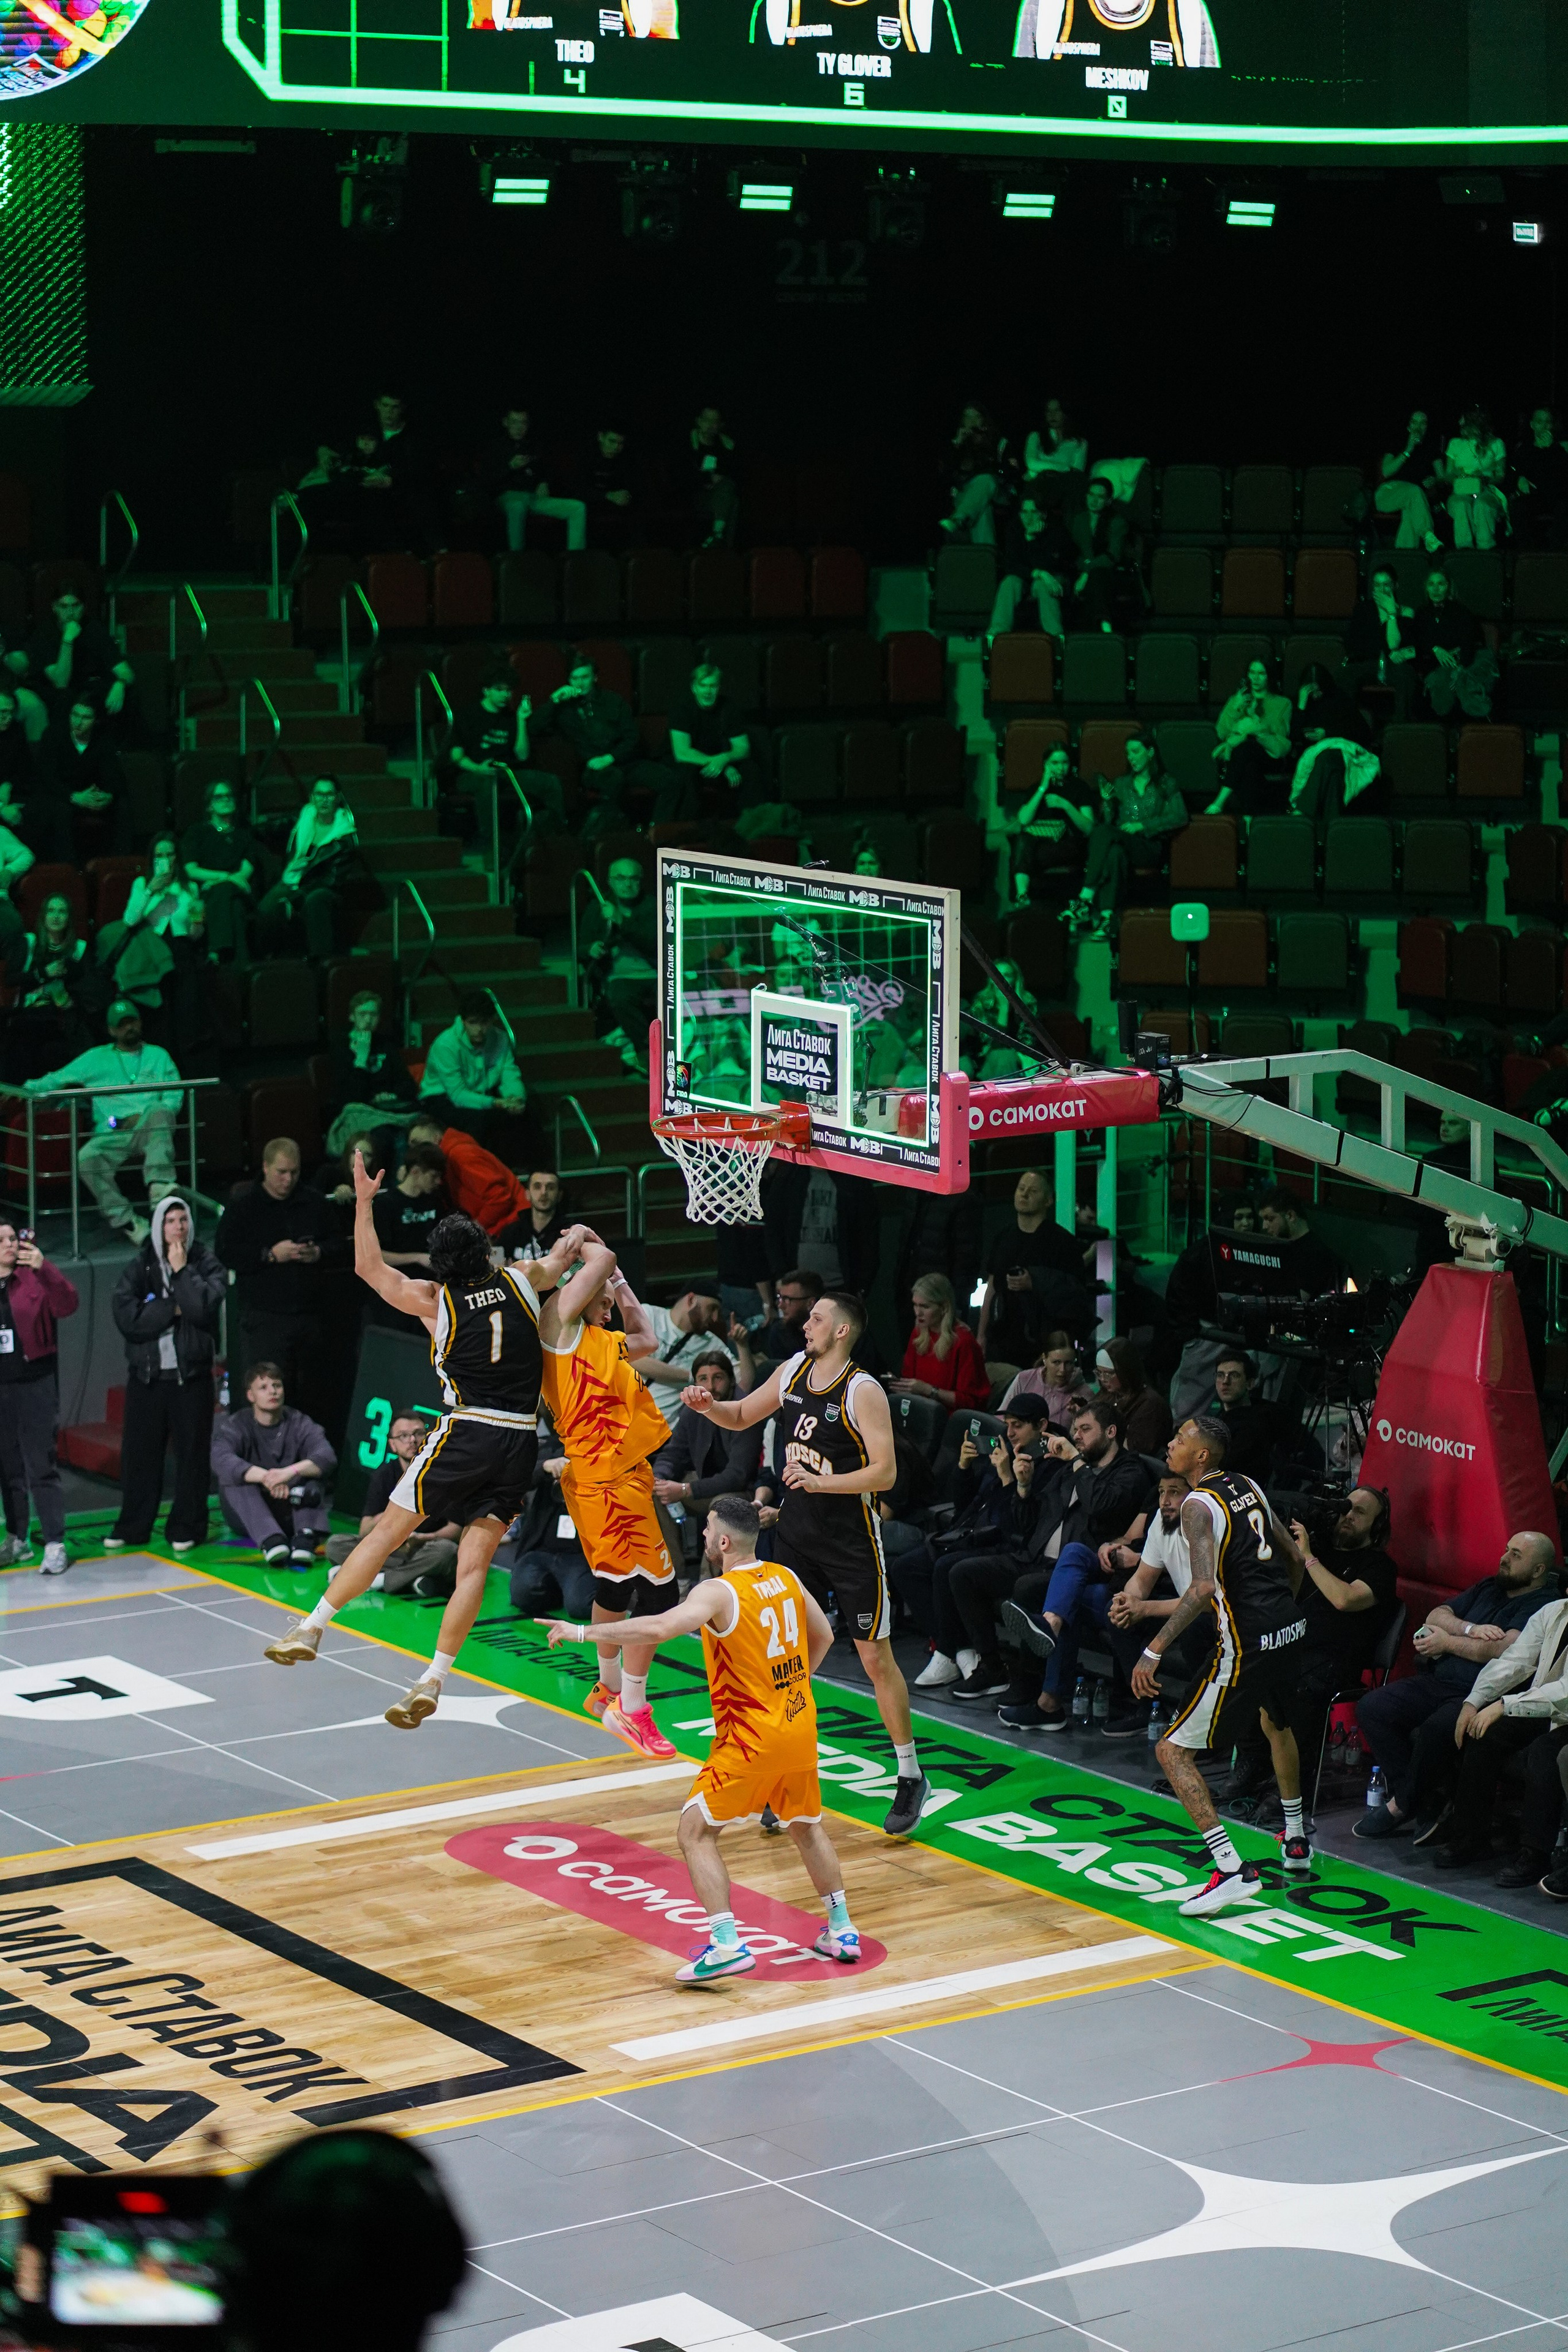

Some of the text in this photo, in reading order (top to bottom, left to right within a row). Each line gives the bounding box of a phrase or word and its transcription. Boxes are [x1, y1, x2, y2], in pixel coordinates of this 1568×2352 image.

[555, 39, 595, 62] THEO
[816, 53, 891, 77] TY GLOVER
[564, 69, 586, 93] 4
[1085, 67, 1149, 91] MESHKOV
[844, 82, 864, 106] 6
[1107, 95, 1127, 118] 0
[775, 239, 869, 285] 212
[767, 1024, 831, 1055] ЛИГА СТАВОК
[767, 1047, 831, 1076] MEDIA
[767, 1067, 831, 1091] BASKET
[989, 1099, 1087, 1126] самокат
[1233, 1249, 1281, 1268] YAMAGUCHI
[464, 1287, 506, 1310] THEO
[489, 1311, 503, 1364] 1
[358, 1396, 393, 1469] 3
[794, 1413, 818, 1440] 13
[1396, 1428, 1476, 1460] самокат
[785, 1442, 833, 1475] MOSCA
[1247, 1509, 1272, 1561] 2
[660, 1549, 671, 1570] 2
[760, 1597, 798, 1659] 24
[70, 1973, 372, 2103] СТАВОК
